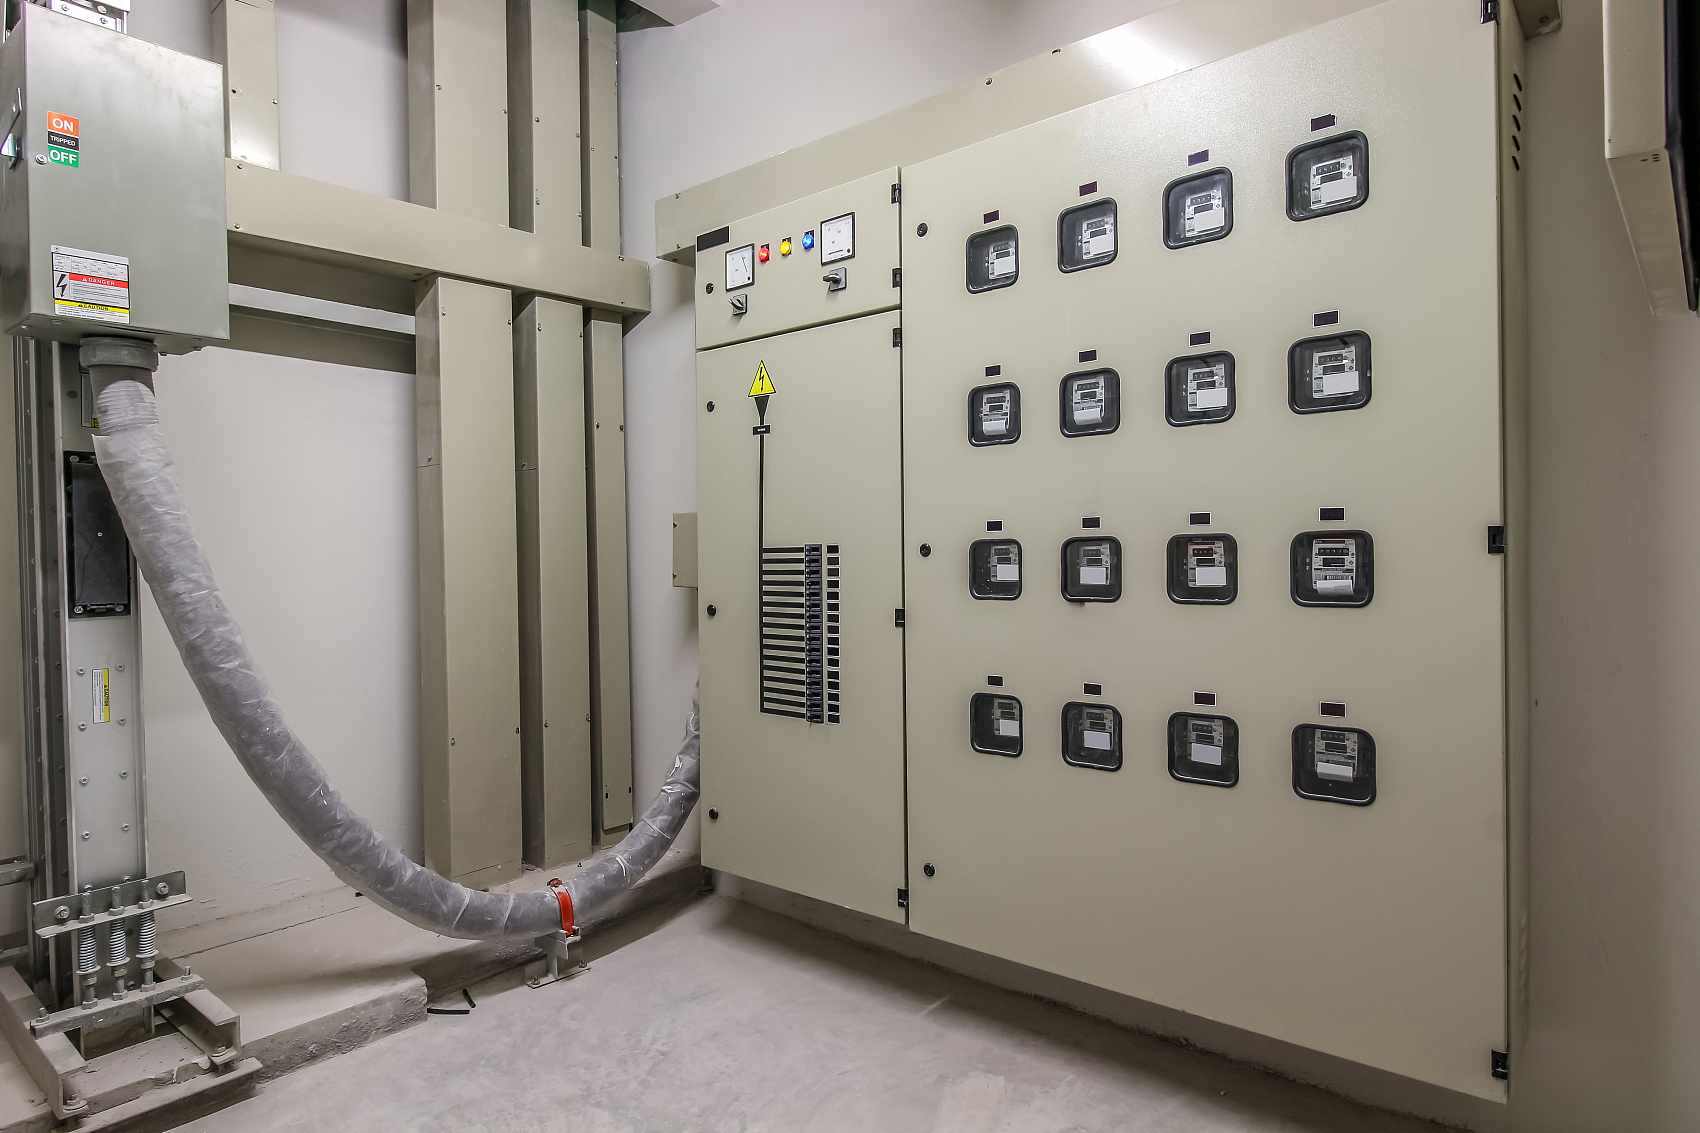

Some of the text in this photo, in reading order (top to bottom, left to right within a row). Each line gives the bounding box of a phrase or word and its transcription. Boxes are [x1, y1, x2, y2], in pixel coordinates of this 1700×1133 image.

[52, 118, 74, 133] ON
[50, 135, 76, 146] TRIPPED
[50, 150, 77, 165] OFF
[89, 278, 115, 286] DANGER
